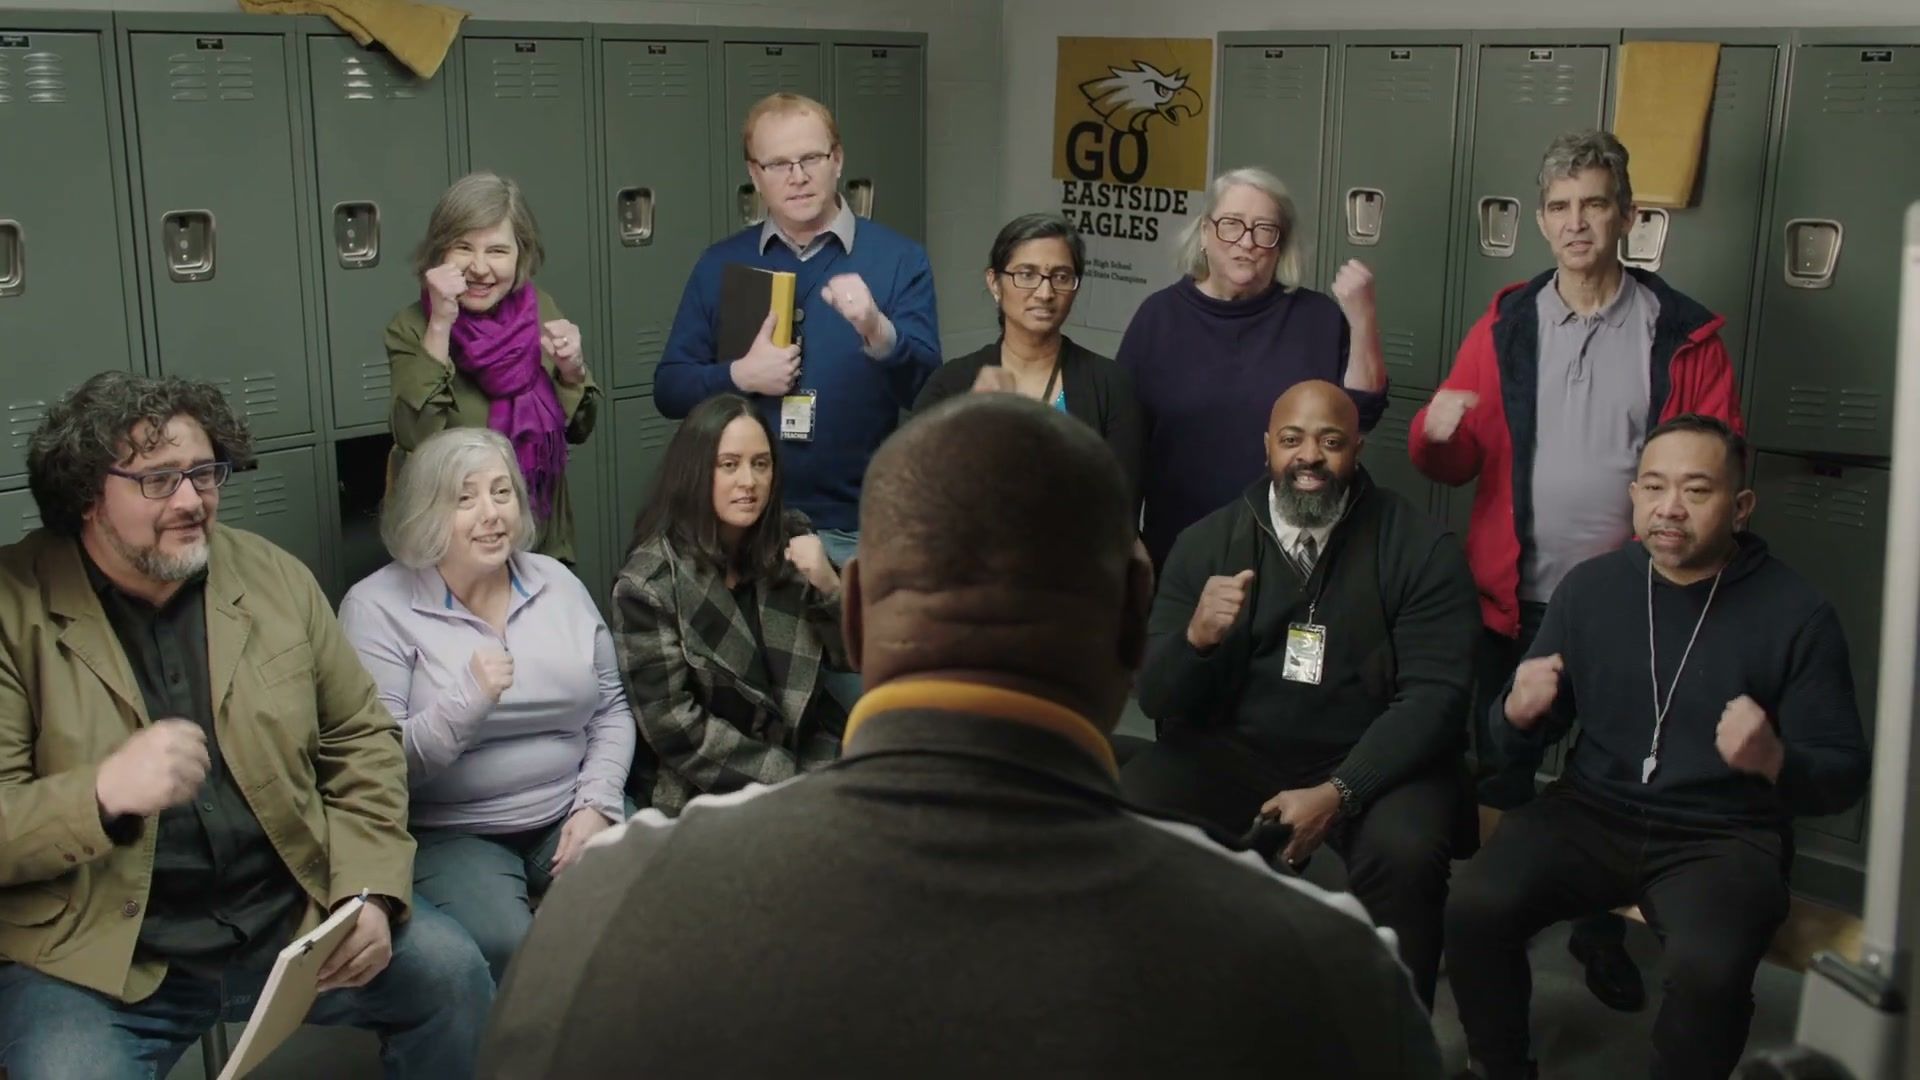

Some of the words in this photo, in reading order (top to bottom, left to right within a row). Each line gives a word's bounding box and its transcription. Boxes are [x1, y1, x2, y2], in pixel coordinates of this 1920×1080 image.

[1066, 121, 1148, 184] GO
[1062, 180, 1189, 216] EASTSIDE
[1093, 258, 1109, 270] High
[1111, 260, 1132, 271] School
[1093, 270, 1110, 280] State
[1111, 271, 1147, 284] Champions
